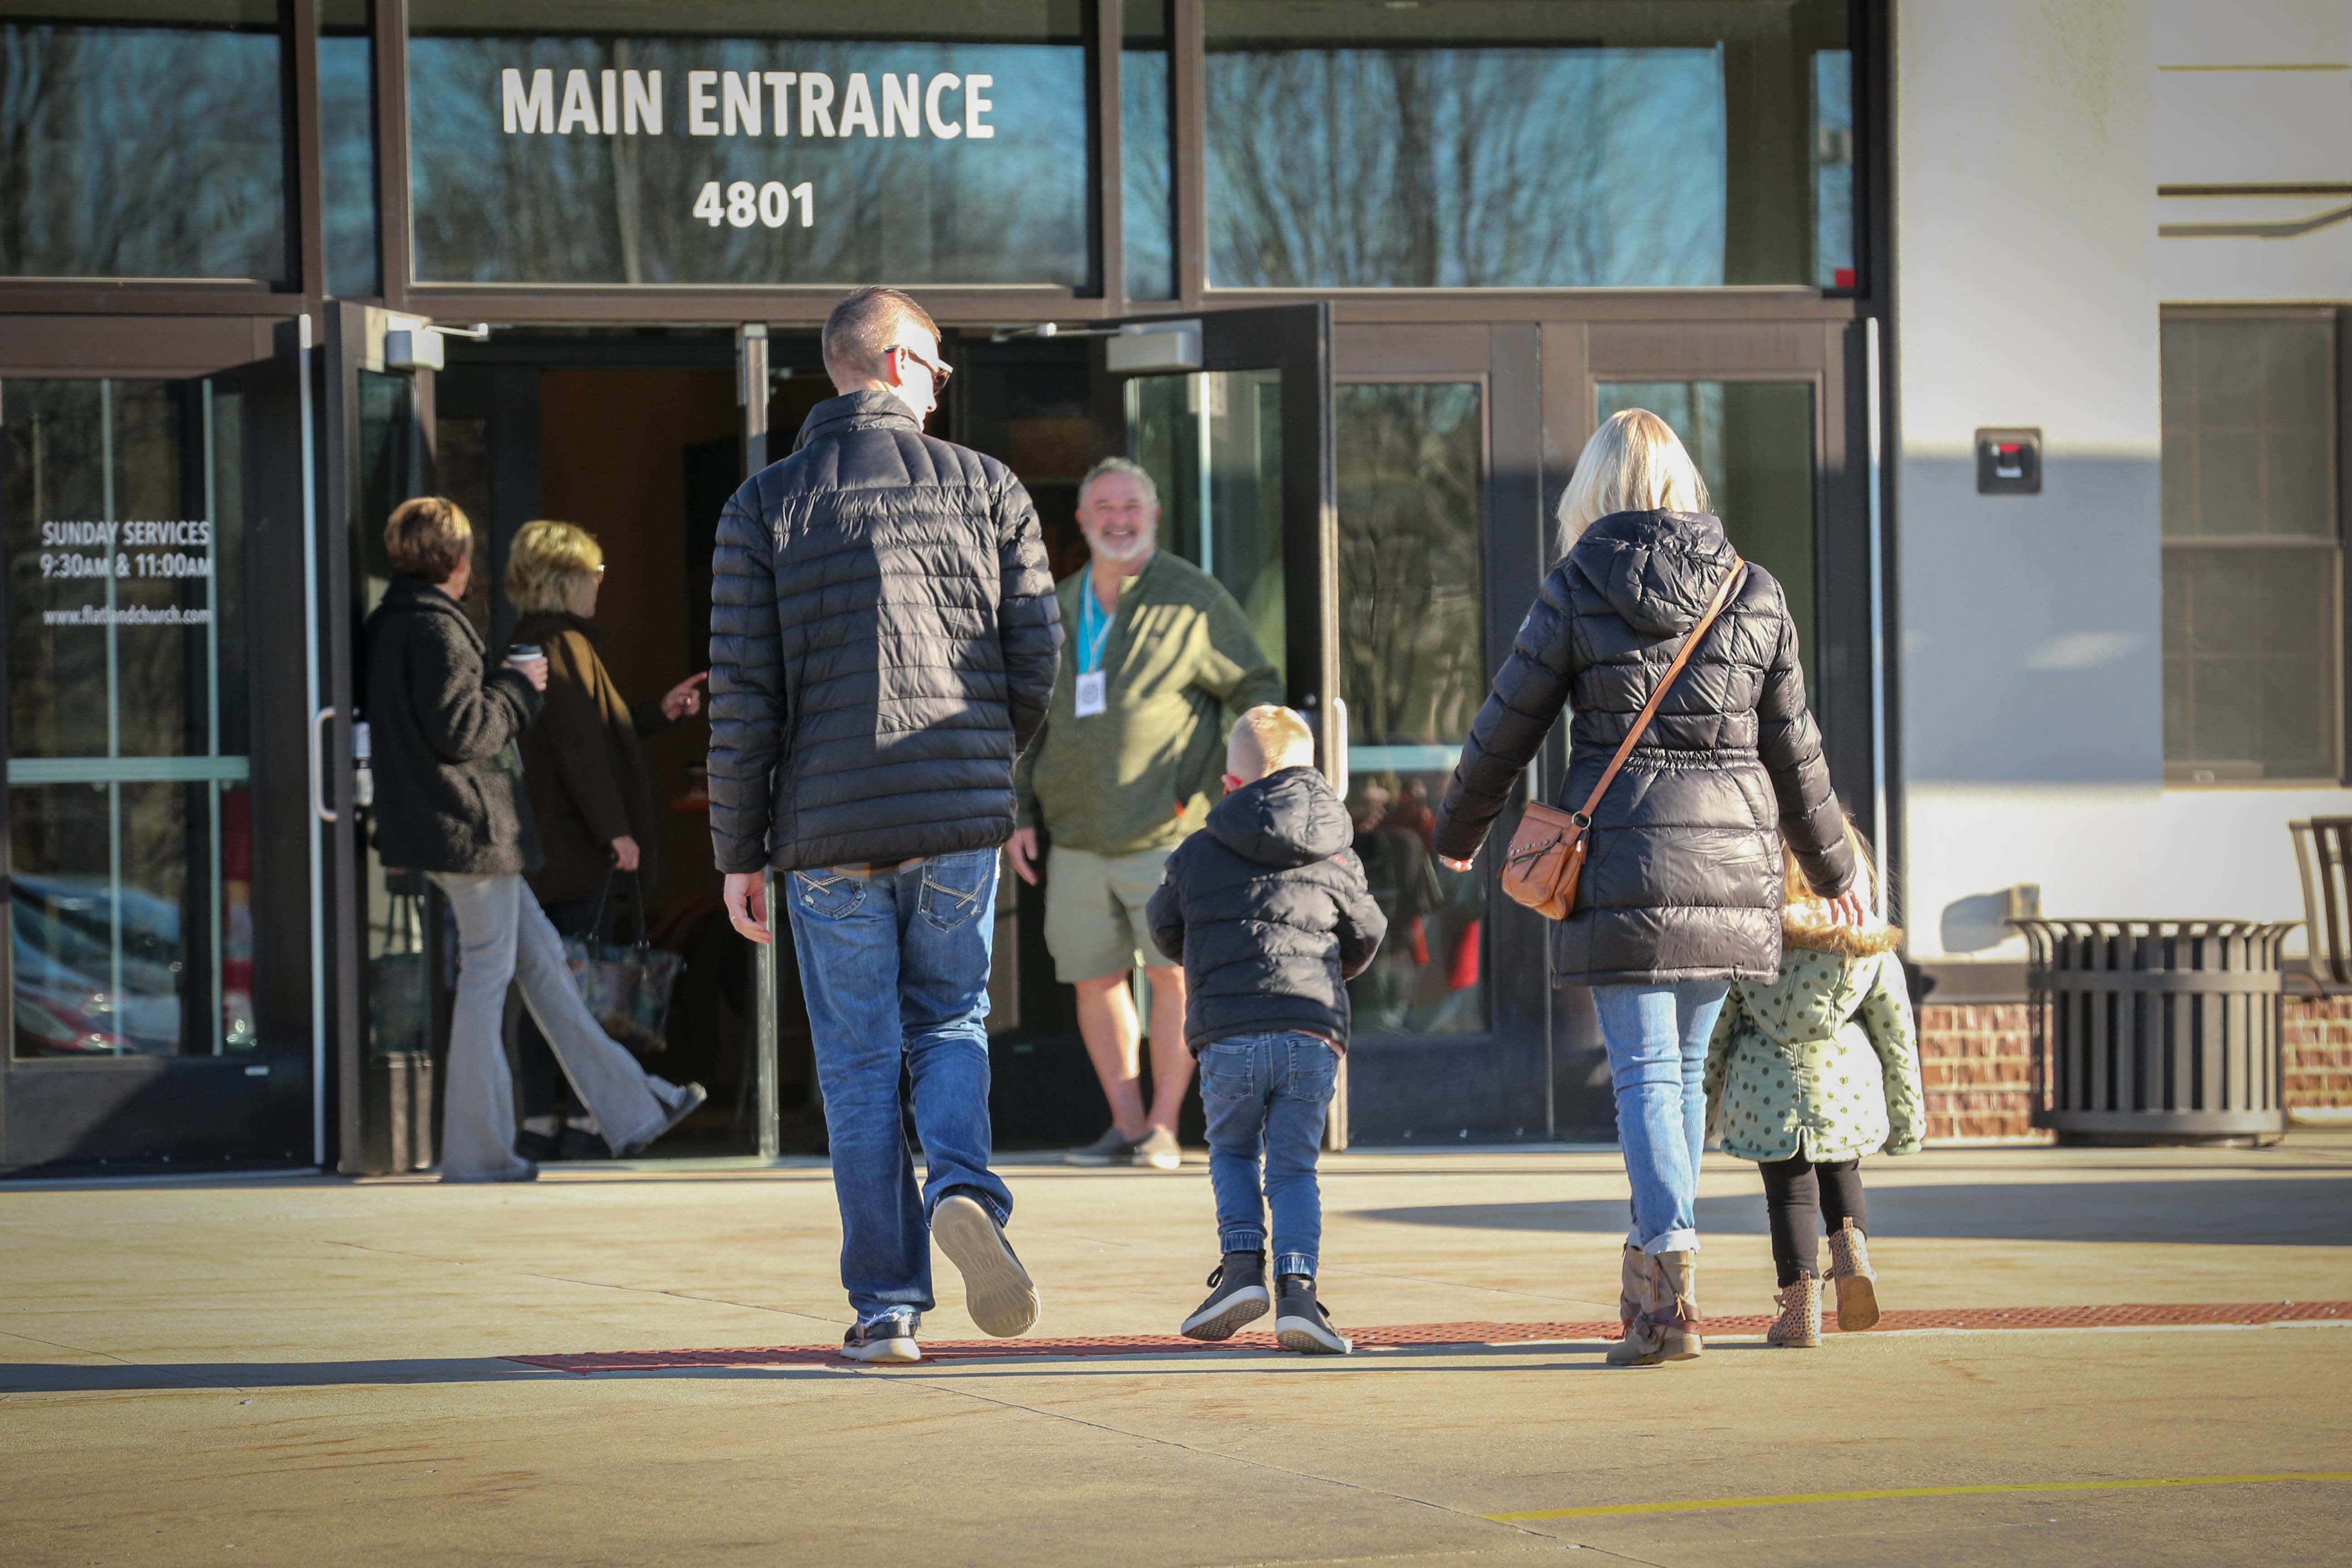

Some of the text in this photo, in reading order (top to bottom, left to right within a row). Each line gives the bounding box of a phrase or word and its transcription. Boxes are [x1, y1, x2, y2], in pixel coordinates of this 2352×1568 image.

[502, 68, 995, 139] MAIN ENTRANCE
[692, 181, 813, 228] 4801
[42, 520, 211, 546] SUNDAY SERVICES
[40, 552, 214, 578] 9:30AM & 11:00AM
